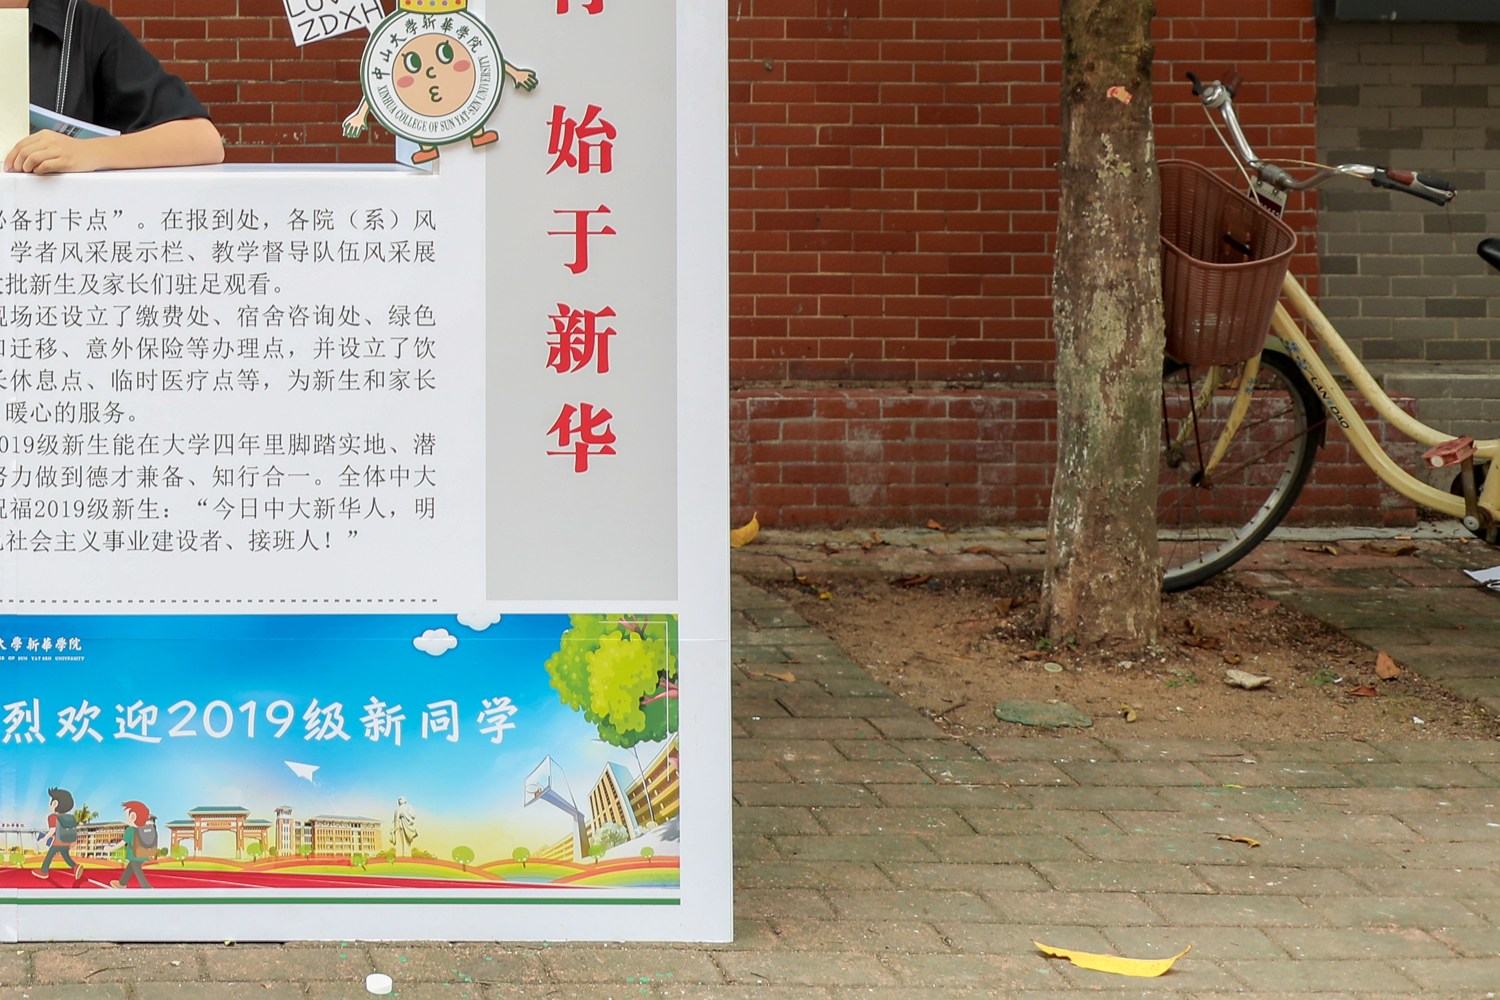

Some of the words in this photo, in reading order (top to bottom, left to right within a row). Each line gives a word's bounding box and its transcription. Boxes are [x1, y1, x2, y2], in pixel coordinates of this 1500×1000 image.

[376, 84, 397, 114] XINHUA
[428, 121, 440, 133] OF
[440, 118, 456, 131] SUN
[546, 105, 617, 473] 始于新华
